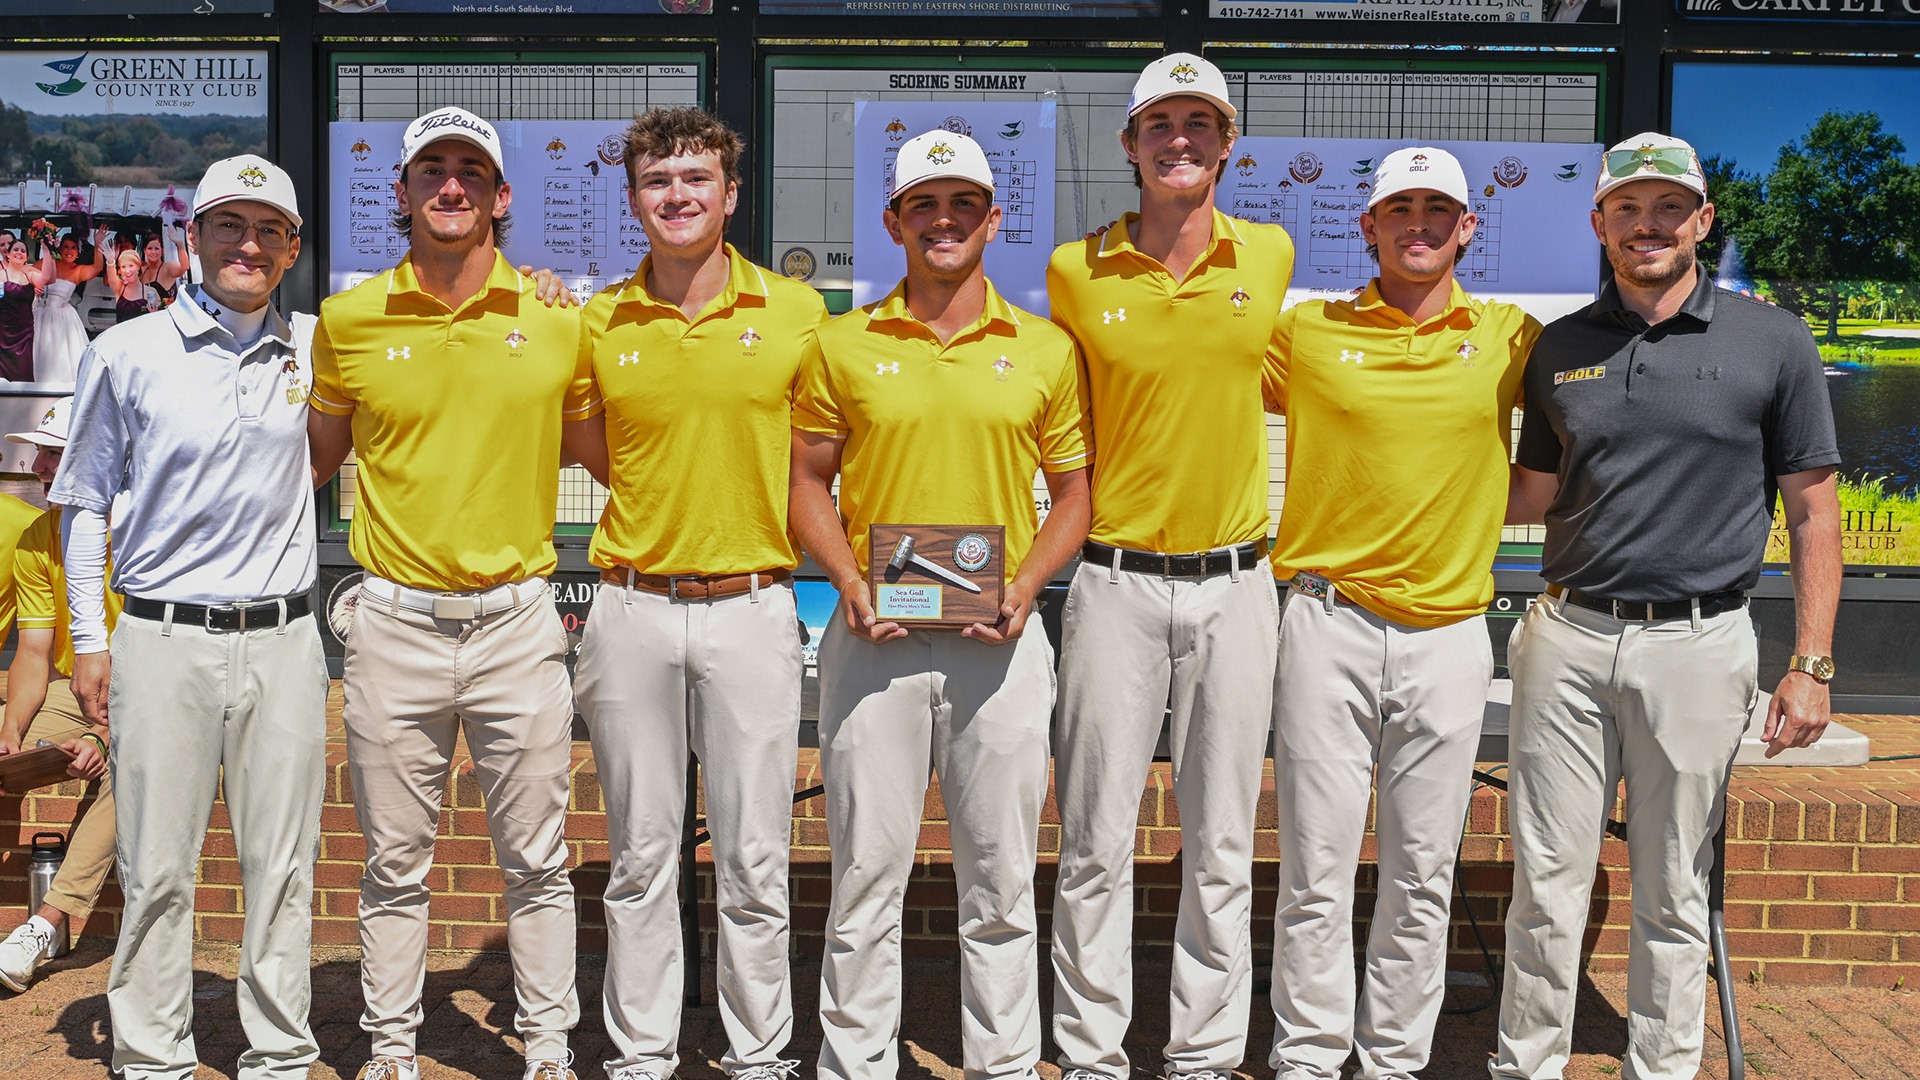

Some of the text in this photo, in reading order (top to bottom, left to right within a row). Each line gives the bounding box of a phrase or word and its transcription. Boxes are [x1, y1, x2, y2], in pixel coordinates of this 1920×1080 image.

[453, 5, 574, 14] North and South Salisbury Blvd.
[846, 2, 909, 10] REPRESENTED
[912, 2, 923, 10] BY
[1003, 3, 1070, 11] DISTRIBUTING
[1219, 8, 1500, 22] 410-742-7141 www.WeisnerRealEstate.com
[91, 58, 262, 80] GREEN HILL
[889, 74, 1026, 90] SCORING SUMMARY
[95, 83, 257, 97] COUNTRY CLUB
[414, 112, 491, 139] Titleist
[1012, 177, 1021, 185] 83
[1272, 200, 1283, 208] 80
[1565, 368, 1604, 381] GOLF
[286, 384, 309, 405] GOLF
